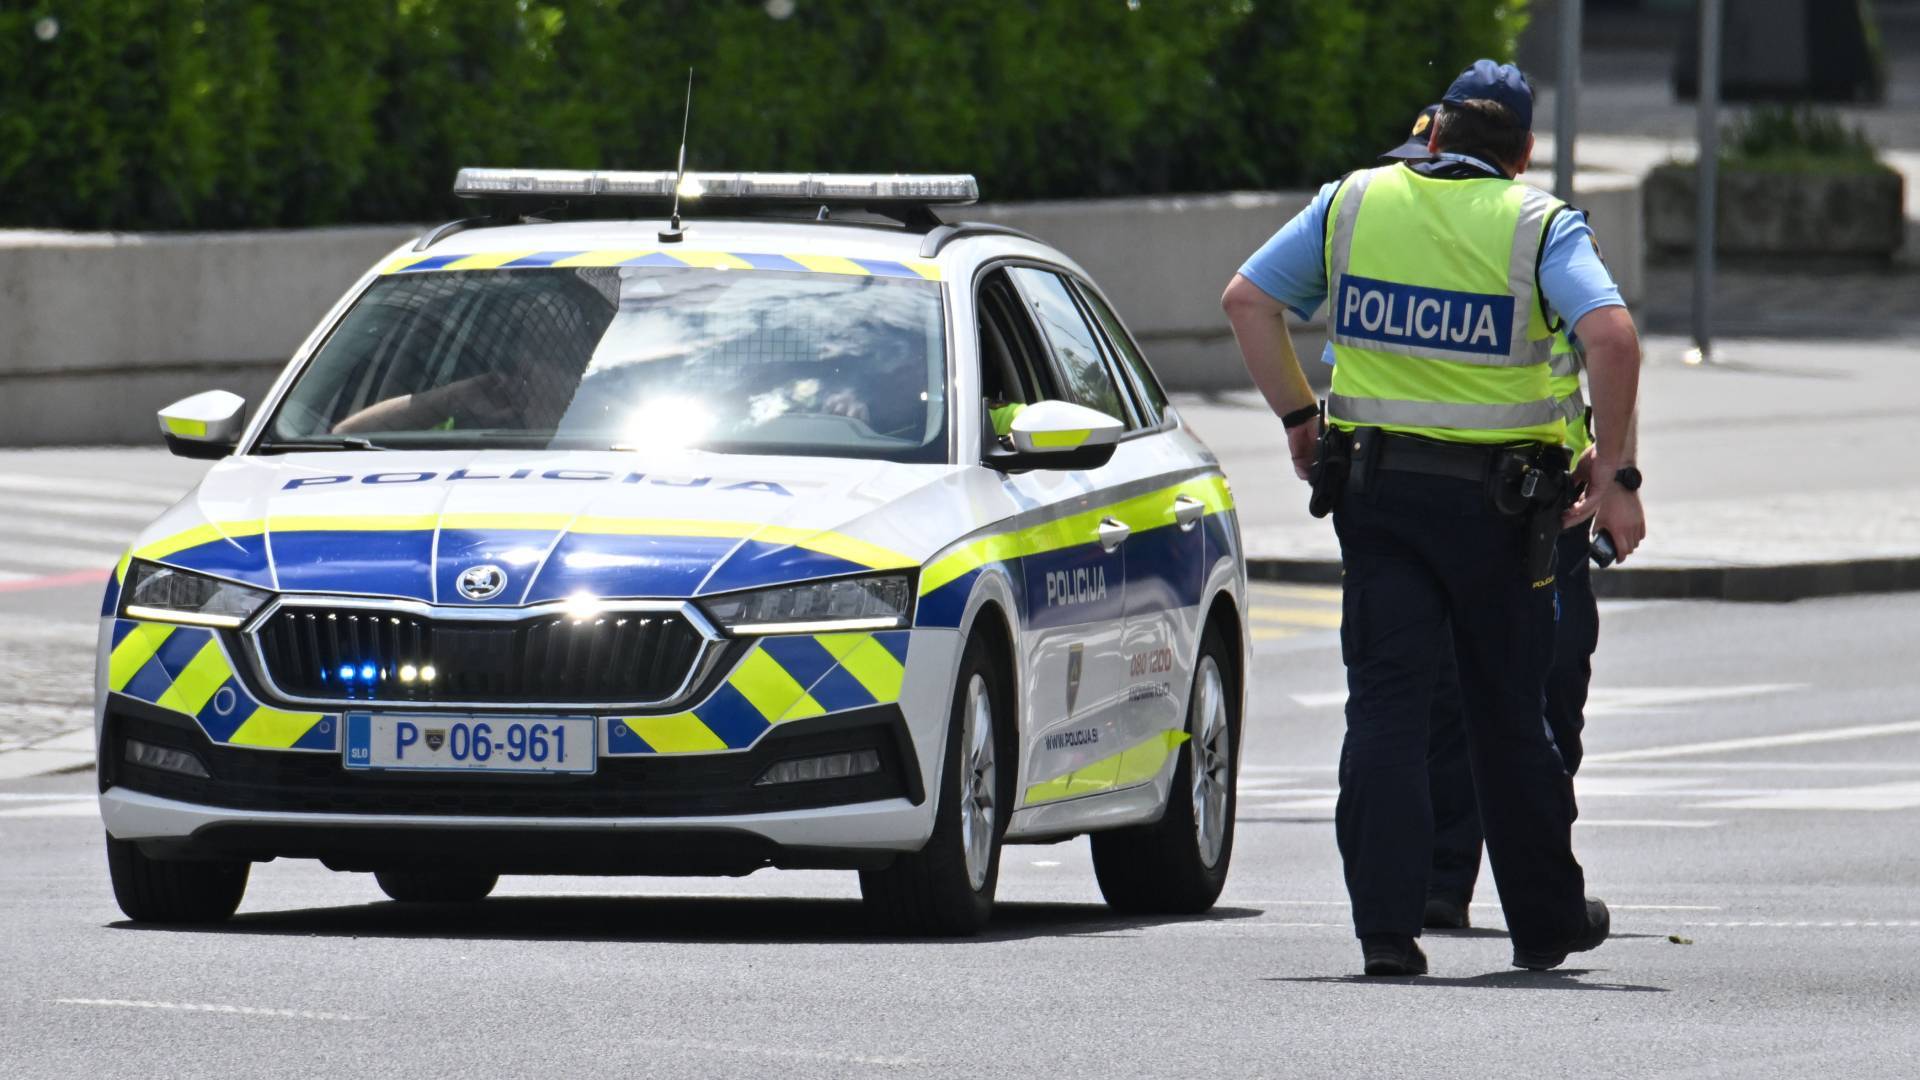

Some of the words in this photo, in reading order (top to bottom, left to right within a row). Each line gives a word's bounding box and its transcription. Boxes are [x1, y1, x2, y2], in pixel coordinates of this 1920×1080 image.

[1343, 285, 1498, 347] POLICIJA
[281, 467, 795, 497] POLICIJA
[1046, 565, 1107, 608] POLICIJA
[1130, 652, 1147, 677] 080
[1149, 648, 1172, 673] 1200
[351, 747, 368, 759] SLO
[396, 721, 418, 760] P
[450, 722, 566, 763] 06-961
[1044, 728, 1098, 751] WWW.POLICIJA.SI
